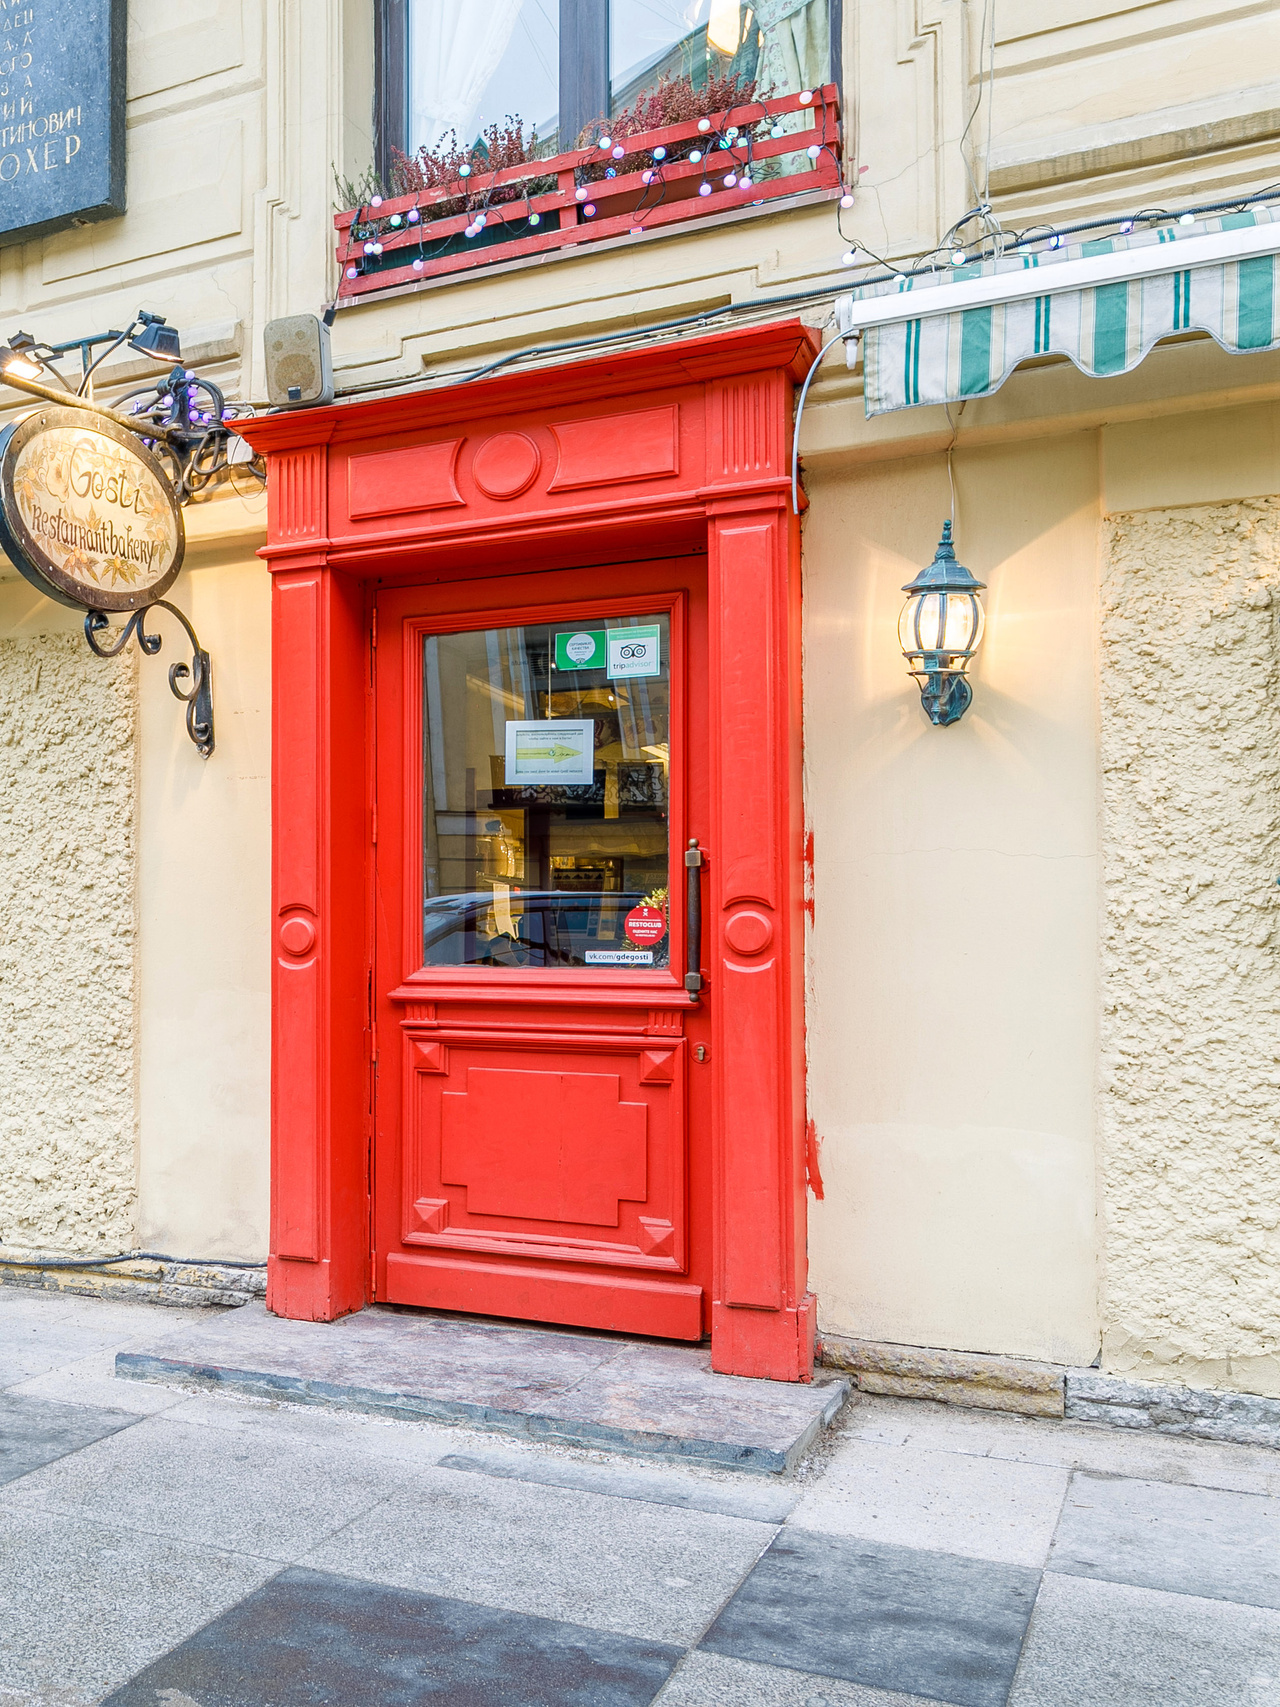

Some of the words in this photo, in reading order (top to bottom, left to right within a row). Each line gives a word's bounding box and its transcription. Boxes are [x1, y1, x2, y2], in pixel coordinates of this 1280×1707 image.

[70, 437, 150, 515] Gosti
[613, 661, 652, 670] tripadvisor
[589, 953, 649, 962] vk.com/gdegosti
